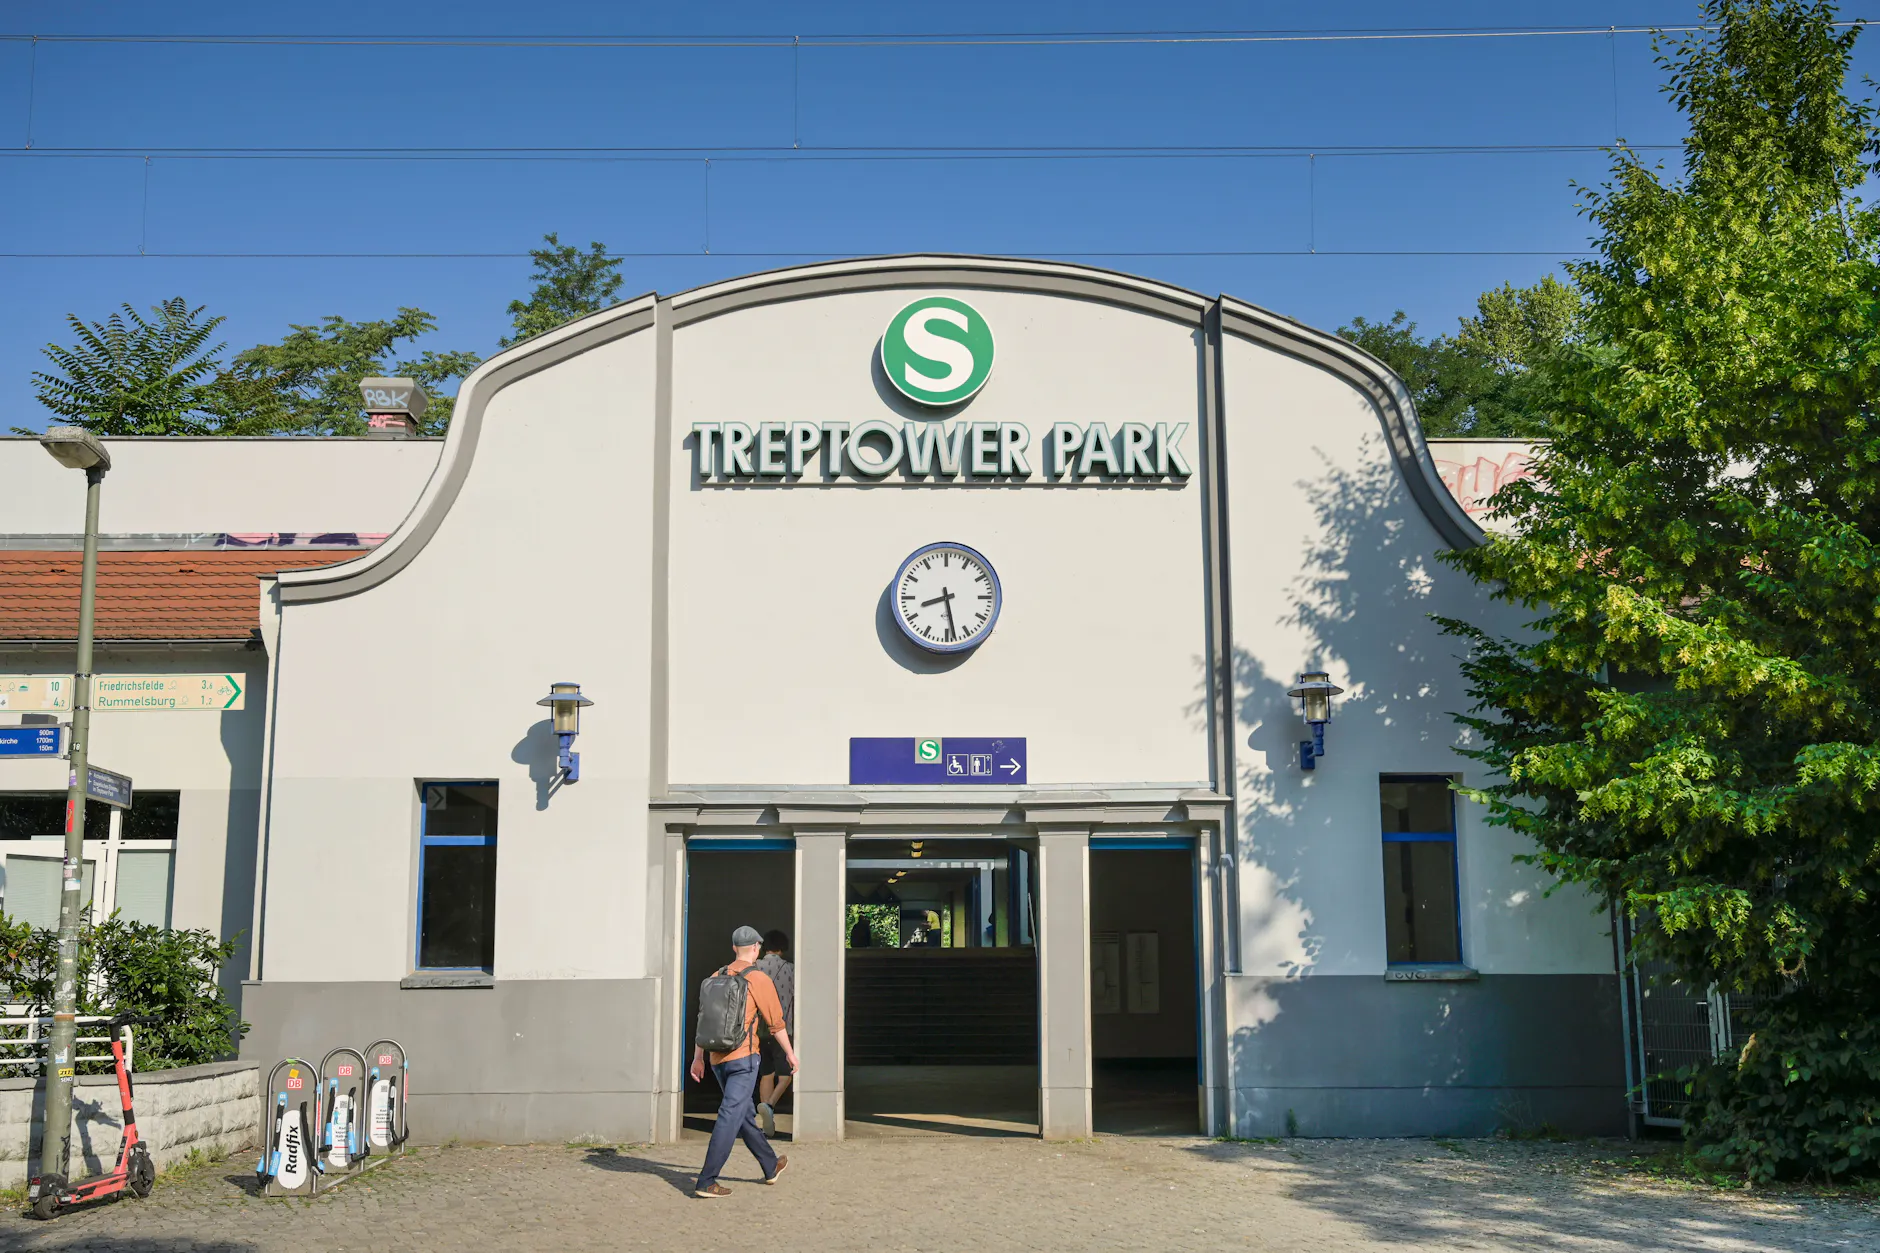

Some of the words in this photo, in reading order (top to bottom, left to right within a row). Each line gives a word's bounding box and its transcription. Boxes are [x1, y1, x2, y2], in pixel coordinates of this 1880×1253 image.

[903, 306, 974, 393] S
[692, 420, 1032, 477] TREPTOWER
[1052, 420, 1193, 477] PARK
[51, 681, 60, 691] 10
[99, 681, 164, 691] Friedrichsfelde
[98, 696, 176, 708] Rummelsburg
[921, 741, 937, 759] S
[380, 1055, 392, 1064] DB
[288, 1079, 302, 1088] DB
[286, 1125, 301, 1174] Radfix
